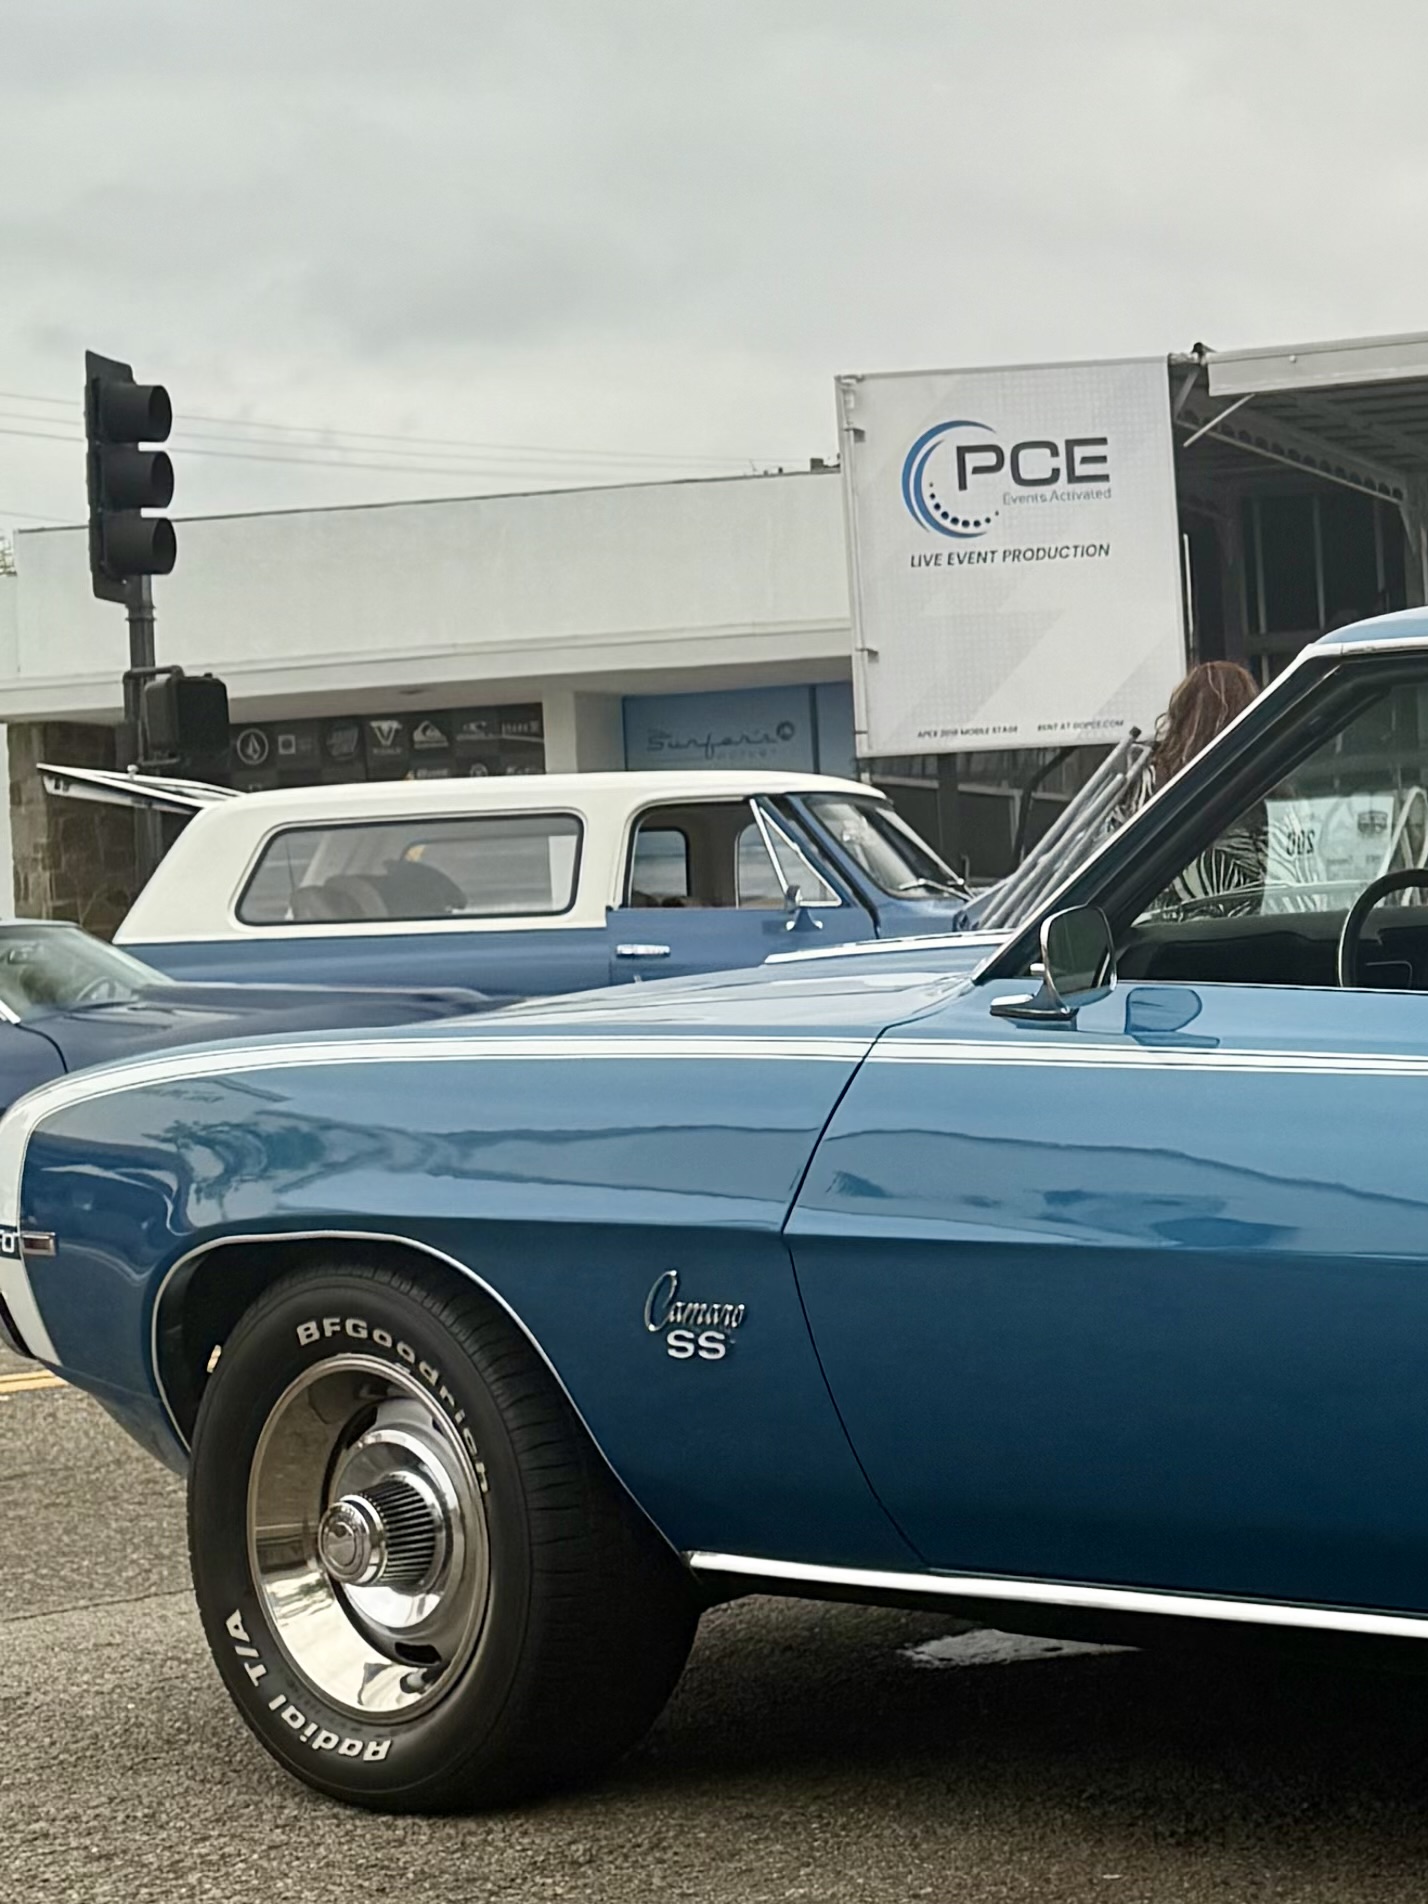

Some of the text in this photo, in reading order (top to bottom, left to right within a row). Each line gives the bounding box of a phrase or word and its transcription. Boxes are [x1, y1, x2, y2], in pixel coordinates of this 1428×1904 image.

[956, 437, 1110, 491] PCE
[1003, 487, 1112, 506] Events Activated
[910, 543, 1111, 568] LIVE EVENT PRODUCTION
[644, 1270, 745, 1332] Camaro
[667, 1329, 726, 1360] SS
[297, 1317, 489, 1493] BFGoodrich
[225, 1608, 392, 1762] Radial T/A
